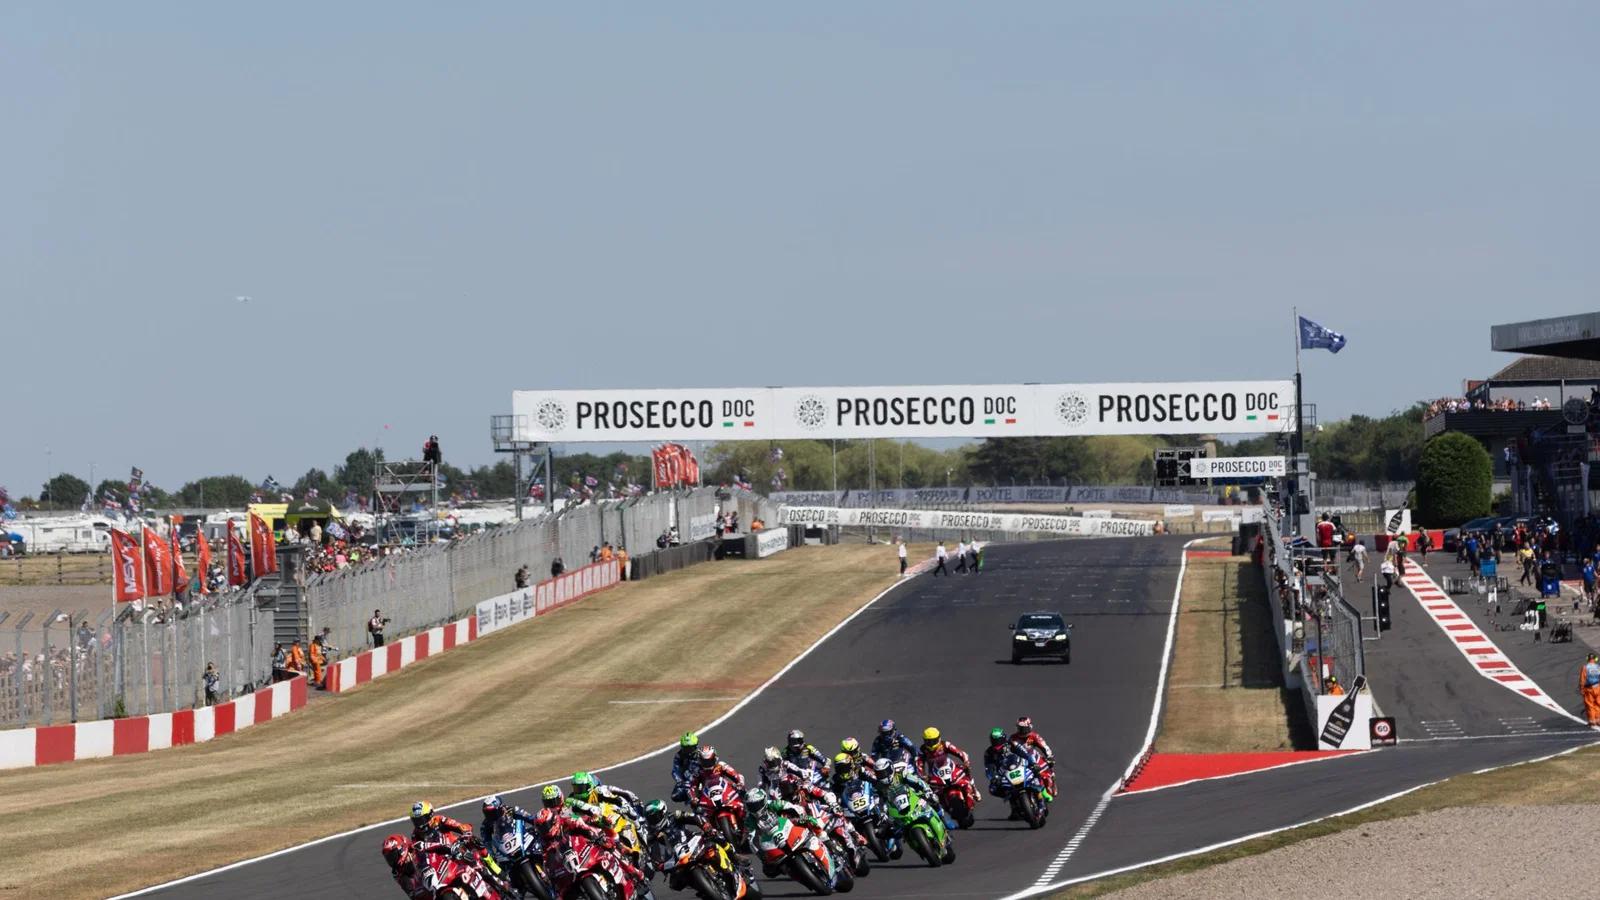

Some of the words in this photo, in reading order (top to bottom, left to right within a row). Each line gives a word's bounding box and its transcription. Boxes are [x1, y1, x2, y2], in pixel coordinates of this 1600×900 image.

[837, 397, 975, 425] PROSECCO
[984, 396, 1016, 414] DOC
[1098, 393, 1237, 422] PROSECCO
[1245, 392, 1278, 411] DOC
[576, 400, 713, 429] PROSECCO
[722, 400, 755, 418] DOC
[1210, 460, 1266, 473] PROSECCO
[1268, 460, 1283, 468] DOC
[785, 509, 825, 521] OSECCO
[859, 512, 907, 525] PROSECCO
[941, 514, 989, 527] PROSECCO
[1022, 517, 1067, 530] PROSECCO
[1100, 521, 1146, 536] PROSECCO
[122, 553, 137, 593] MSV
[1377, 725, 1389, 733] 60
[1008, 769, 1021, 780] 62
[852, 798, 867, 809] 55
[504, 837, 517, 852] 97
